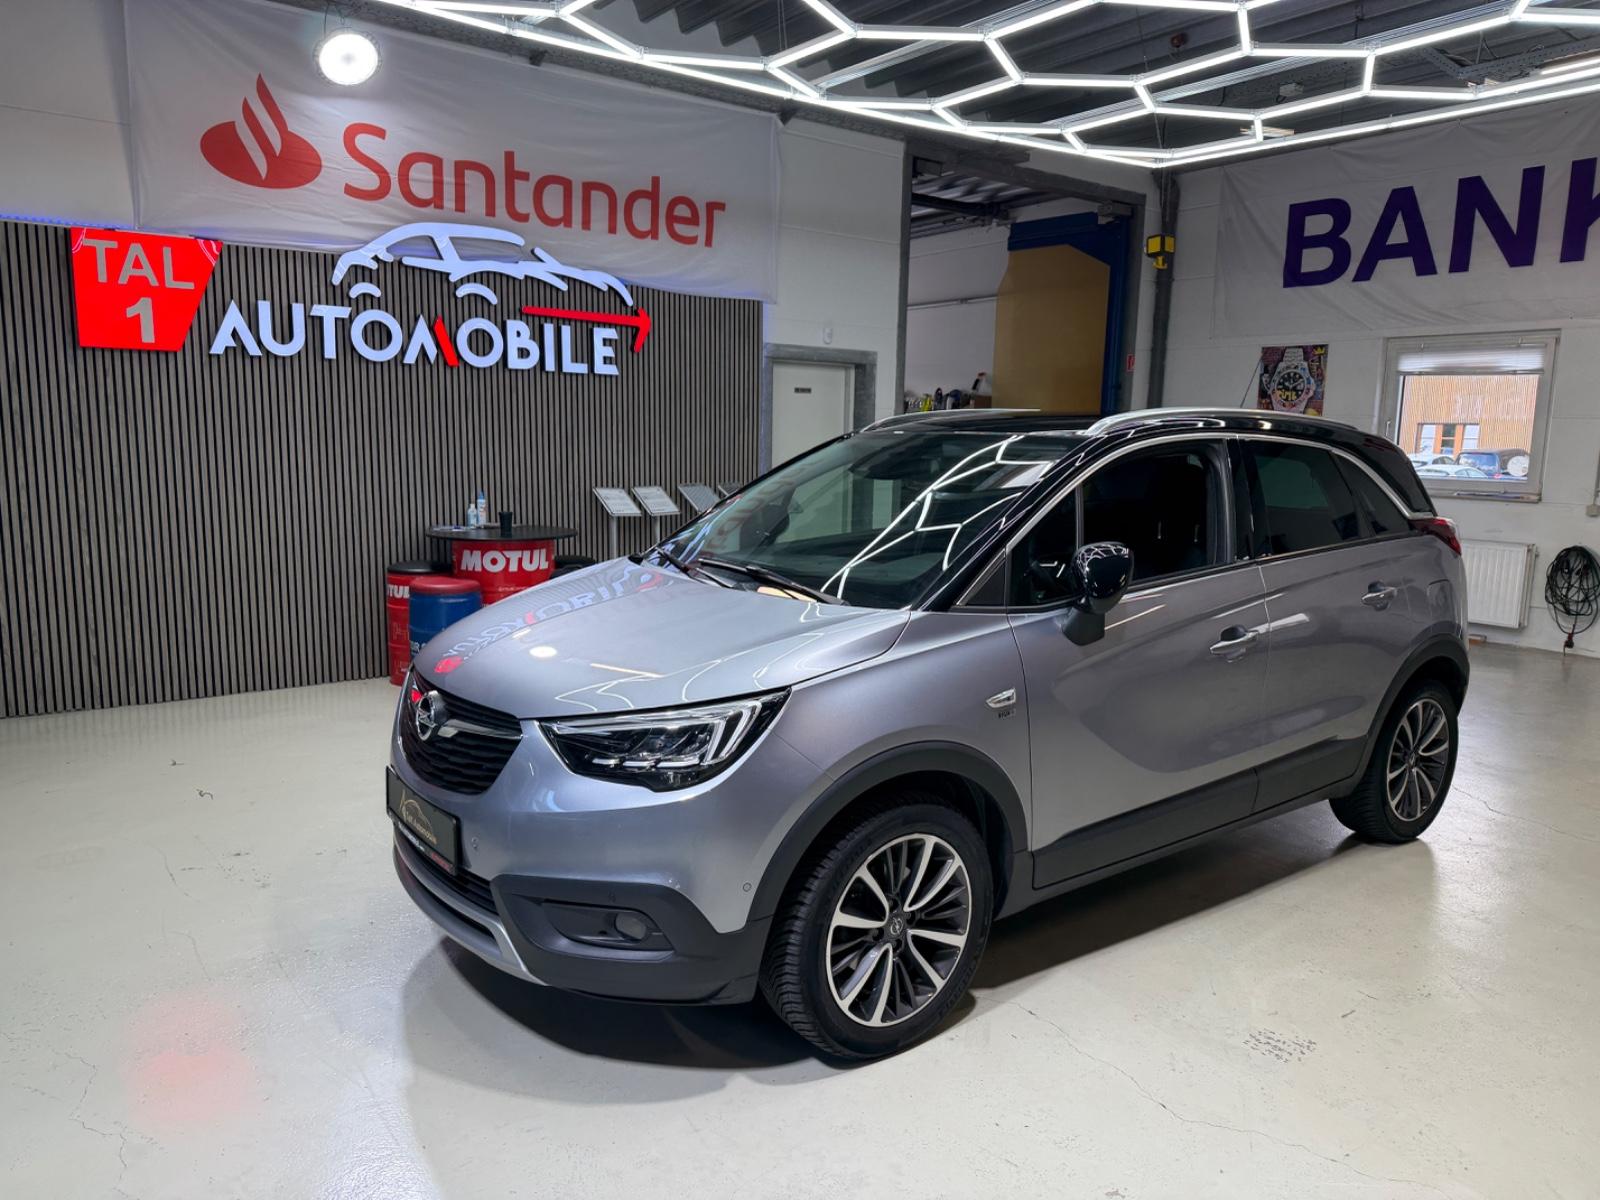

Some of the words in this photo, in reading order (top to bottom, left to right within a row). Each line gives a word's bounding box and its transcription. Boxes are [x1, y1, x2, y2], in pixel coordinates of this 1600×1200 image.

[342, 122, 726, 248] Santander
[82, 237, 195, 290] TAL
[125, 296, 156, 344] 1
[208, 300, 620, 376] AUTOMOBILE
[460, 548, 549, 573] MOTUL
[387, 584, 410, 599] TUL
